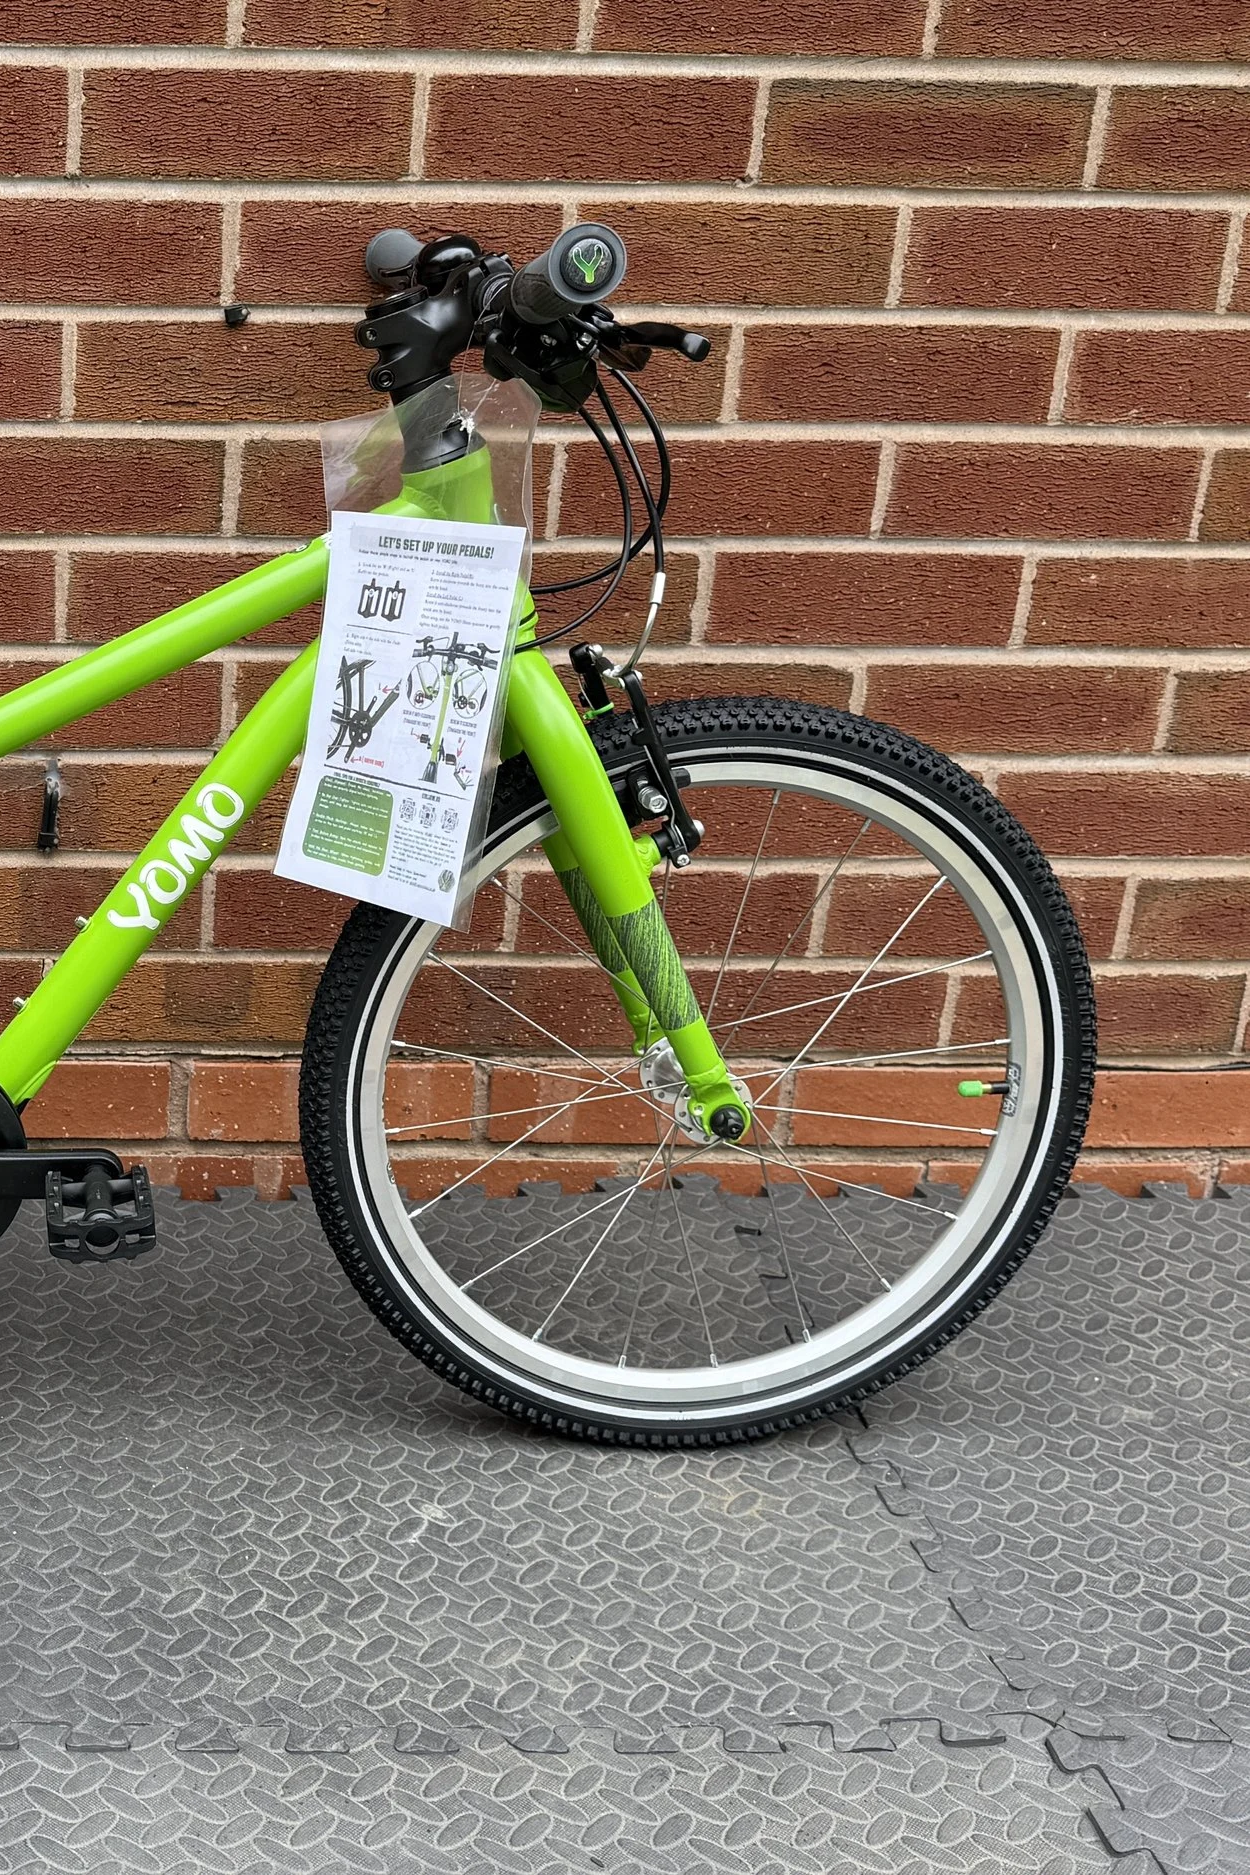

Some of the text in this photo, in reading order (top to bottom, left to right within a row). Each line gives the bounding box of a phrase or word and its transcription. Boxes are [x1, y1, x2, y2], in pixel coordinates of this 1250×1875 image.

[379, 536, 402, 550] LET'S
[403, 538, 421, 552] SET
[422, 541, 435, 553] UP
[437, 542, 458, 556] YOUR
[459, 544, 495, 559] PEDALS!
[107, 783, 245, 931] YOMO
